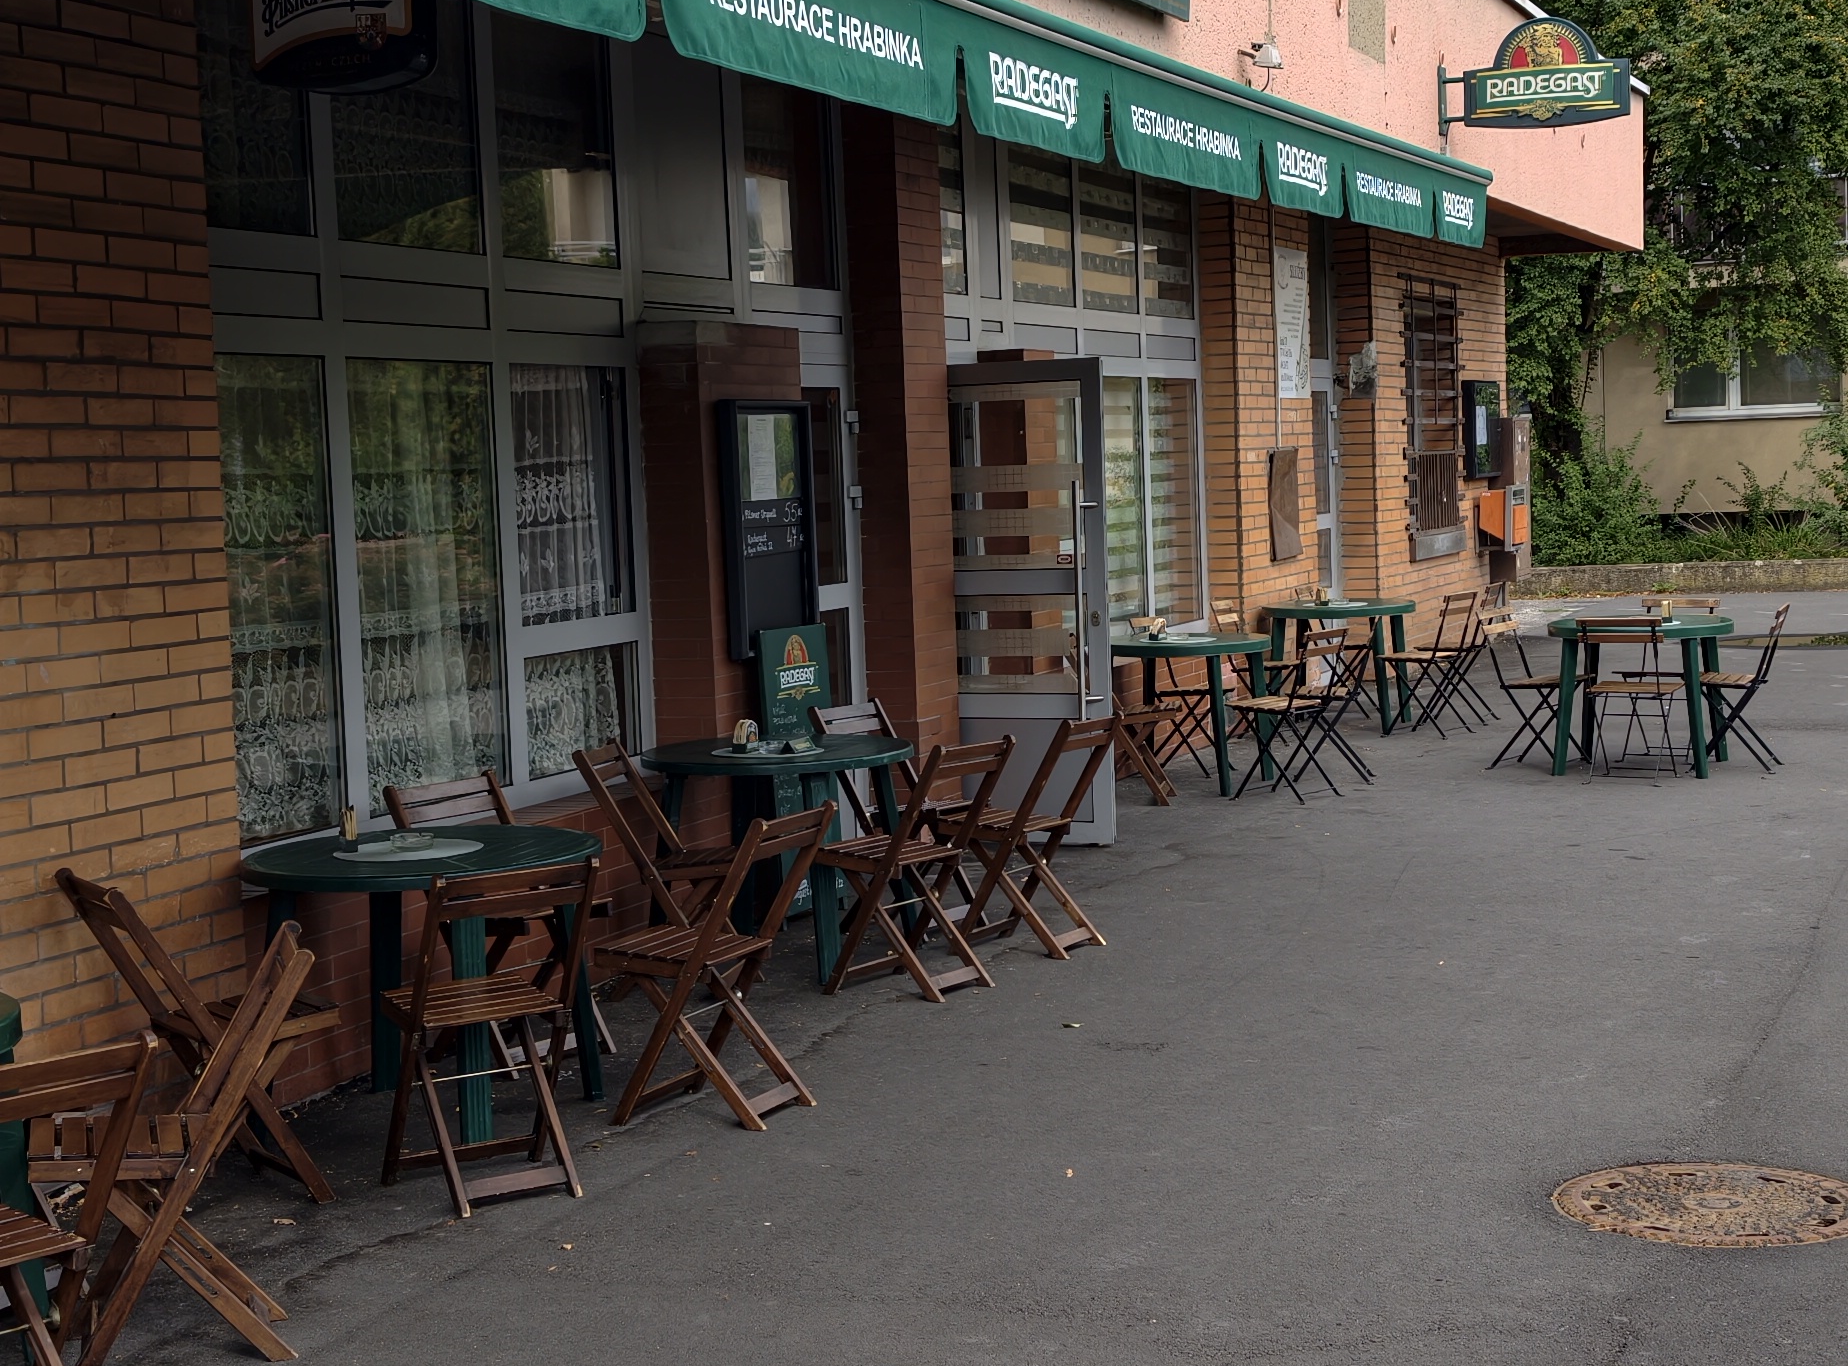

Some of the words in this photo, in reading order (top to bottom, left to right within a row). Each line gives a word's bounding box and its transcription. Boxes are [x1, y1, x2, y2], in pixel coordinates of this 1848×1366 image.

[838, 13, 924, 70] HRABINKA
[989, 52, 1079, 129] RADEGAST
[1486, 70, 1607, 103] RADEGAST
[1131, 105, 1194, 148] RESTAURACE
[1195, 125, 1242, 161] HRABINKA
[1276, 141, 1328, 196] RADEGAST
[1356, 172, 1394, 201] RESTAURACE
[1394, 183, 1422, 208] HRABINKA
[1442, 190, 1474, 230] RADEGAST
[783, 502, 798, 522] 55
[780, 667, 815, 689] RADEGAST
